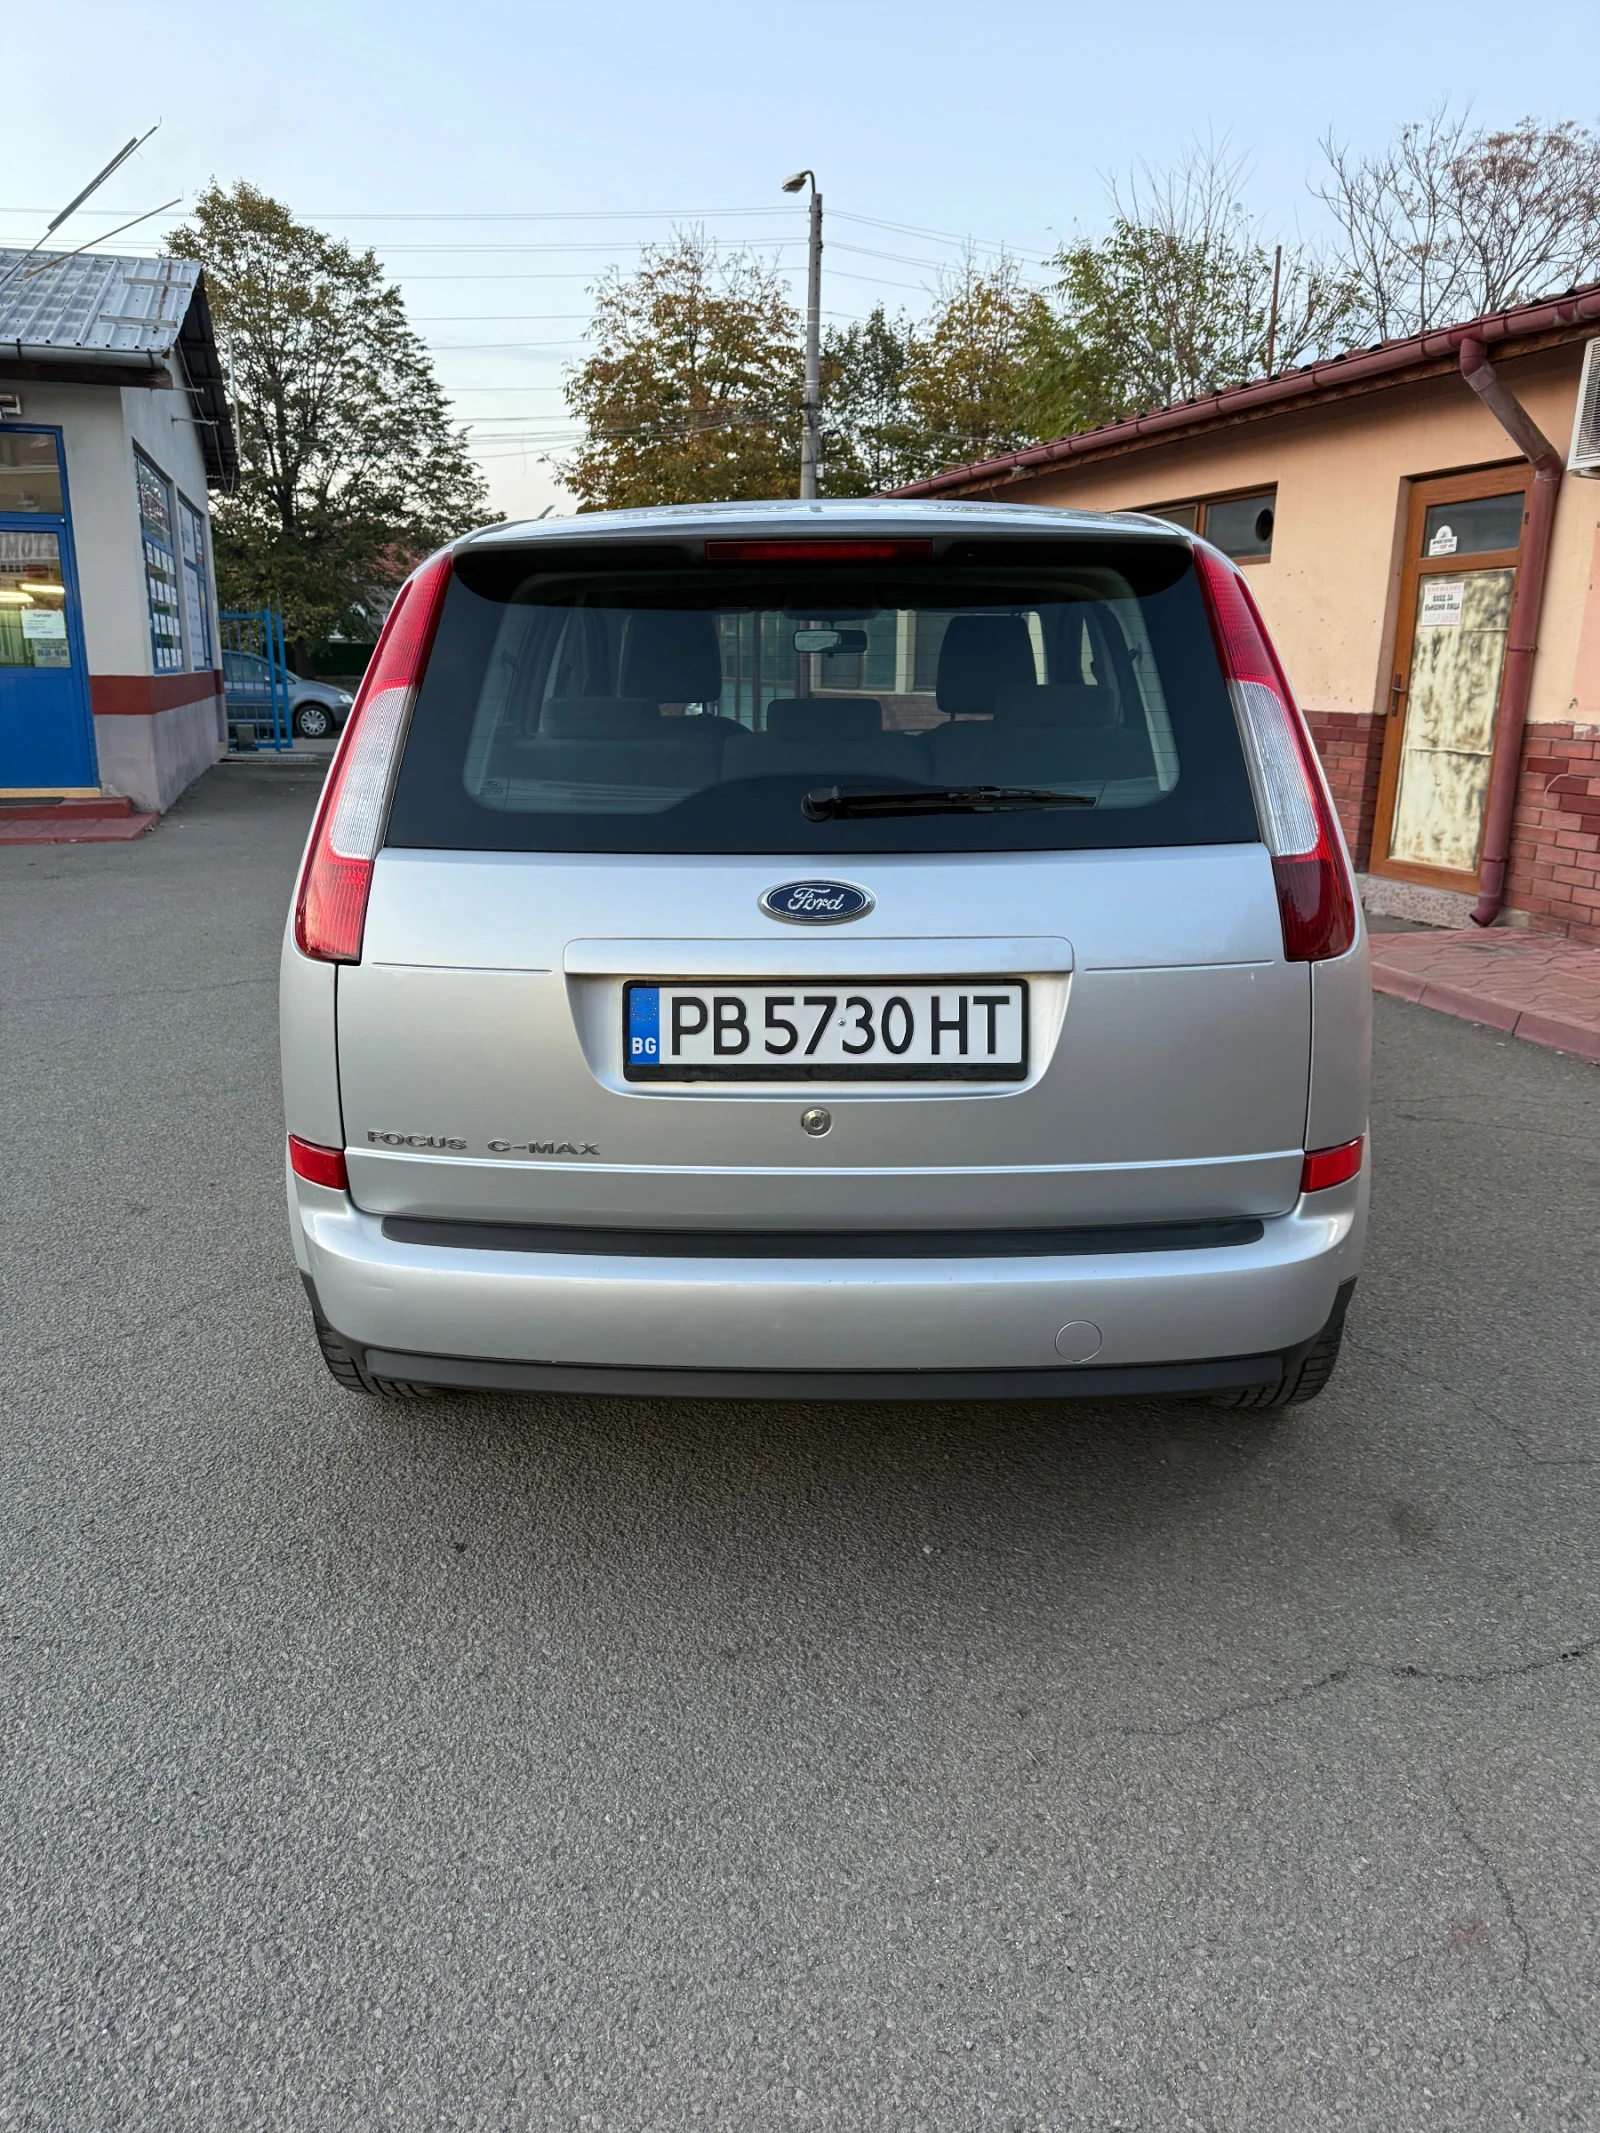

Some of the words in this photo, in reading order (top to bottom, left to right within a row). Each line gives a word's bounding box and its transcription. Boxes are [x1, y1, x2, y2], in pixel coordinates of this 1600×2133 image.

[787, 887, 845, 910] Ford
[671, 996, 750, 1056] PB
[765, 995, 915, 1056] 5730
[930, 995, 1011, 1056] HT
[632, 1037, 657, 1055] BG
[366, 1128, 467, 1150] FOCUS
[487, 1138, 601, 1155] C-MAX
